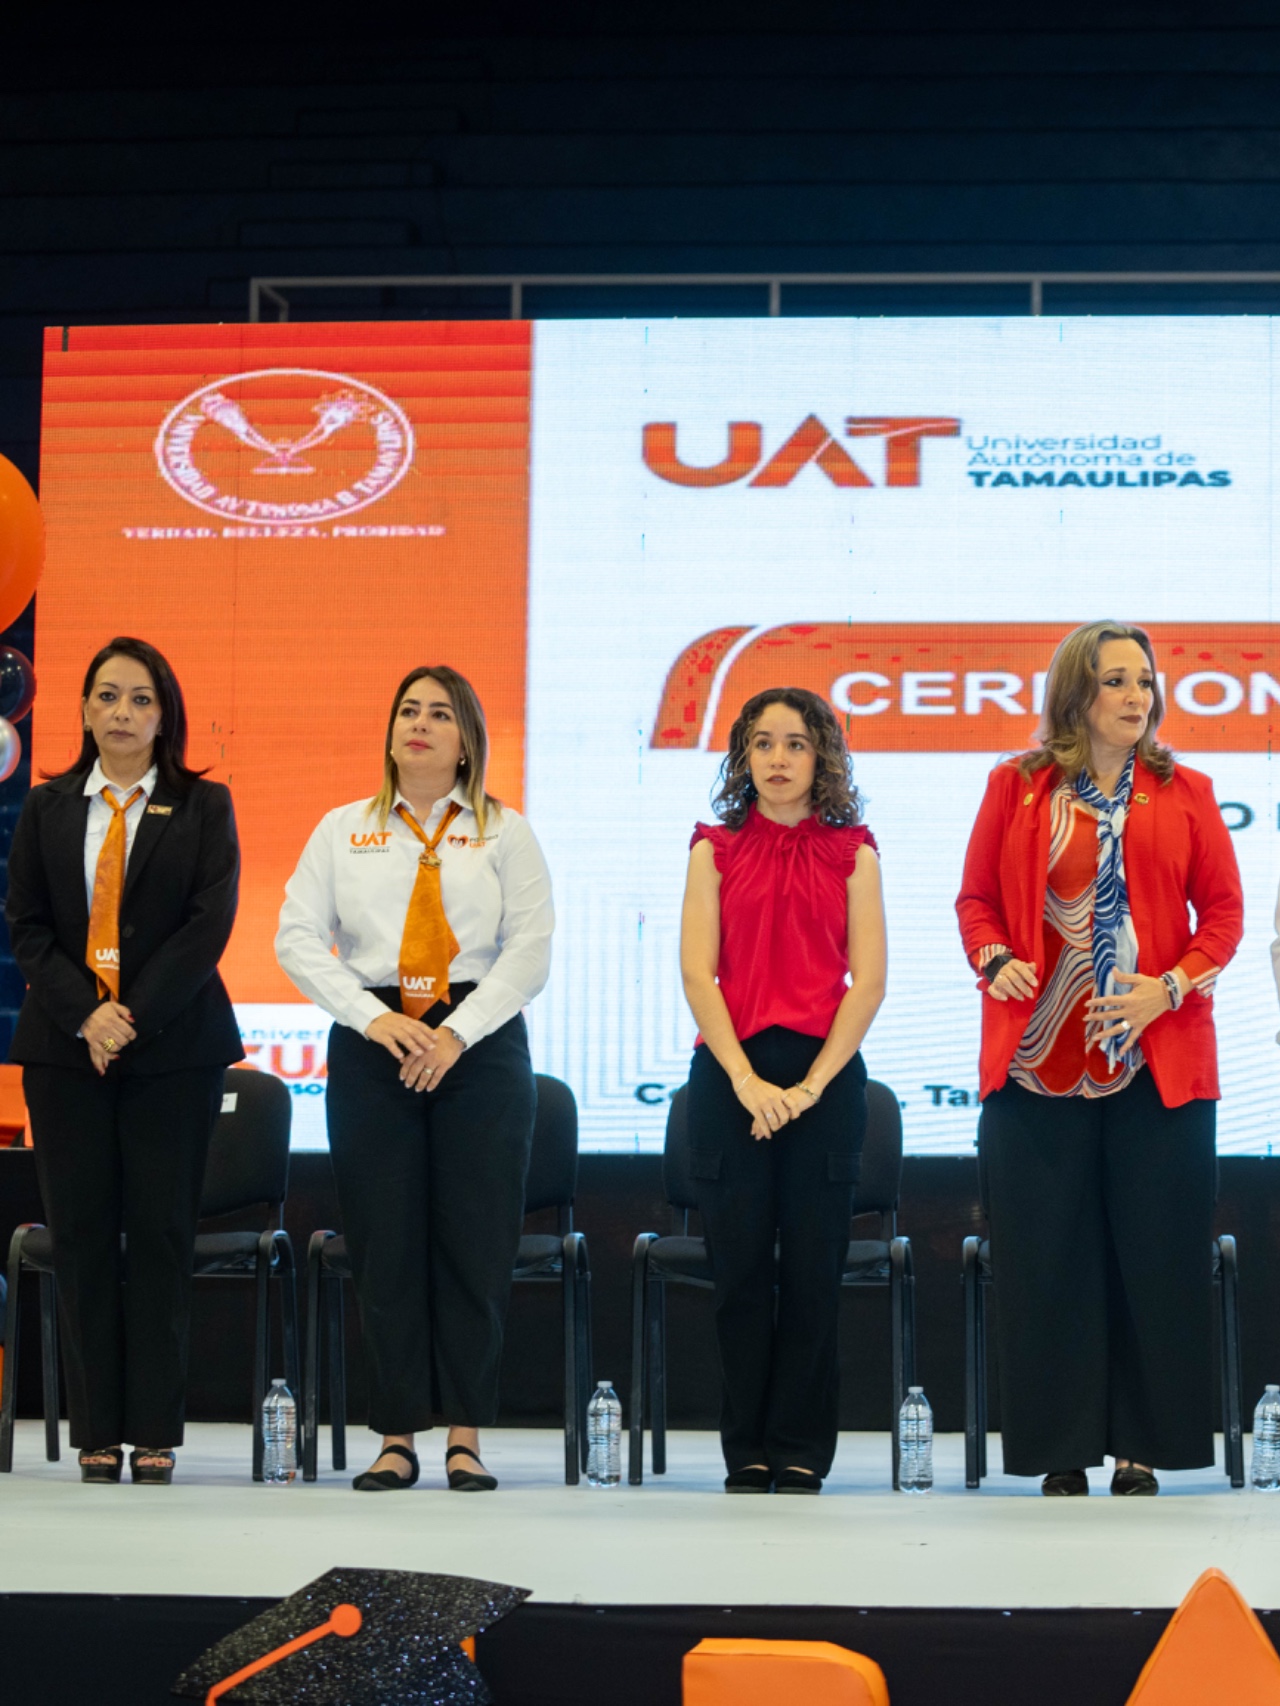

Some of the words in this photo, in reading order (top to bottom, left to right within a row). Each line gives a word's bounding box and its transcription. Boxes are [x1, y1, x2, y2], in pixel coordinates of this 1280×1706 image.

[642, 413, 961, 487] UAT
[966, 434, 1162, 451] Universidad
[966, 449, 1143, 467] Autónoma
[1154, 450, 1196, 467] de
[967, 470, 1232, 488] TAMAULIPAS
[350, 832, 392, 847] UAT
[402, 975, 437, 990] UAT
